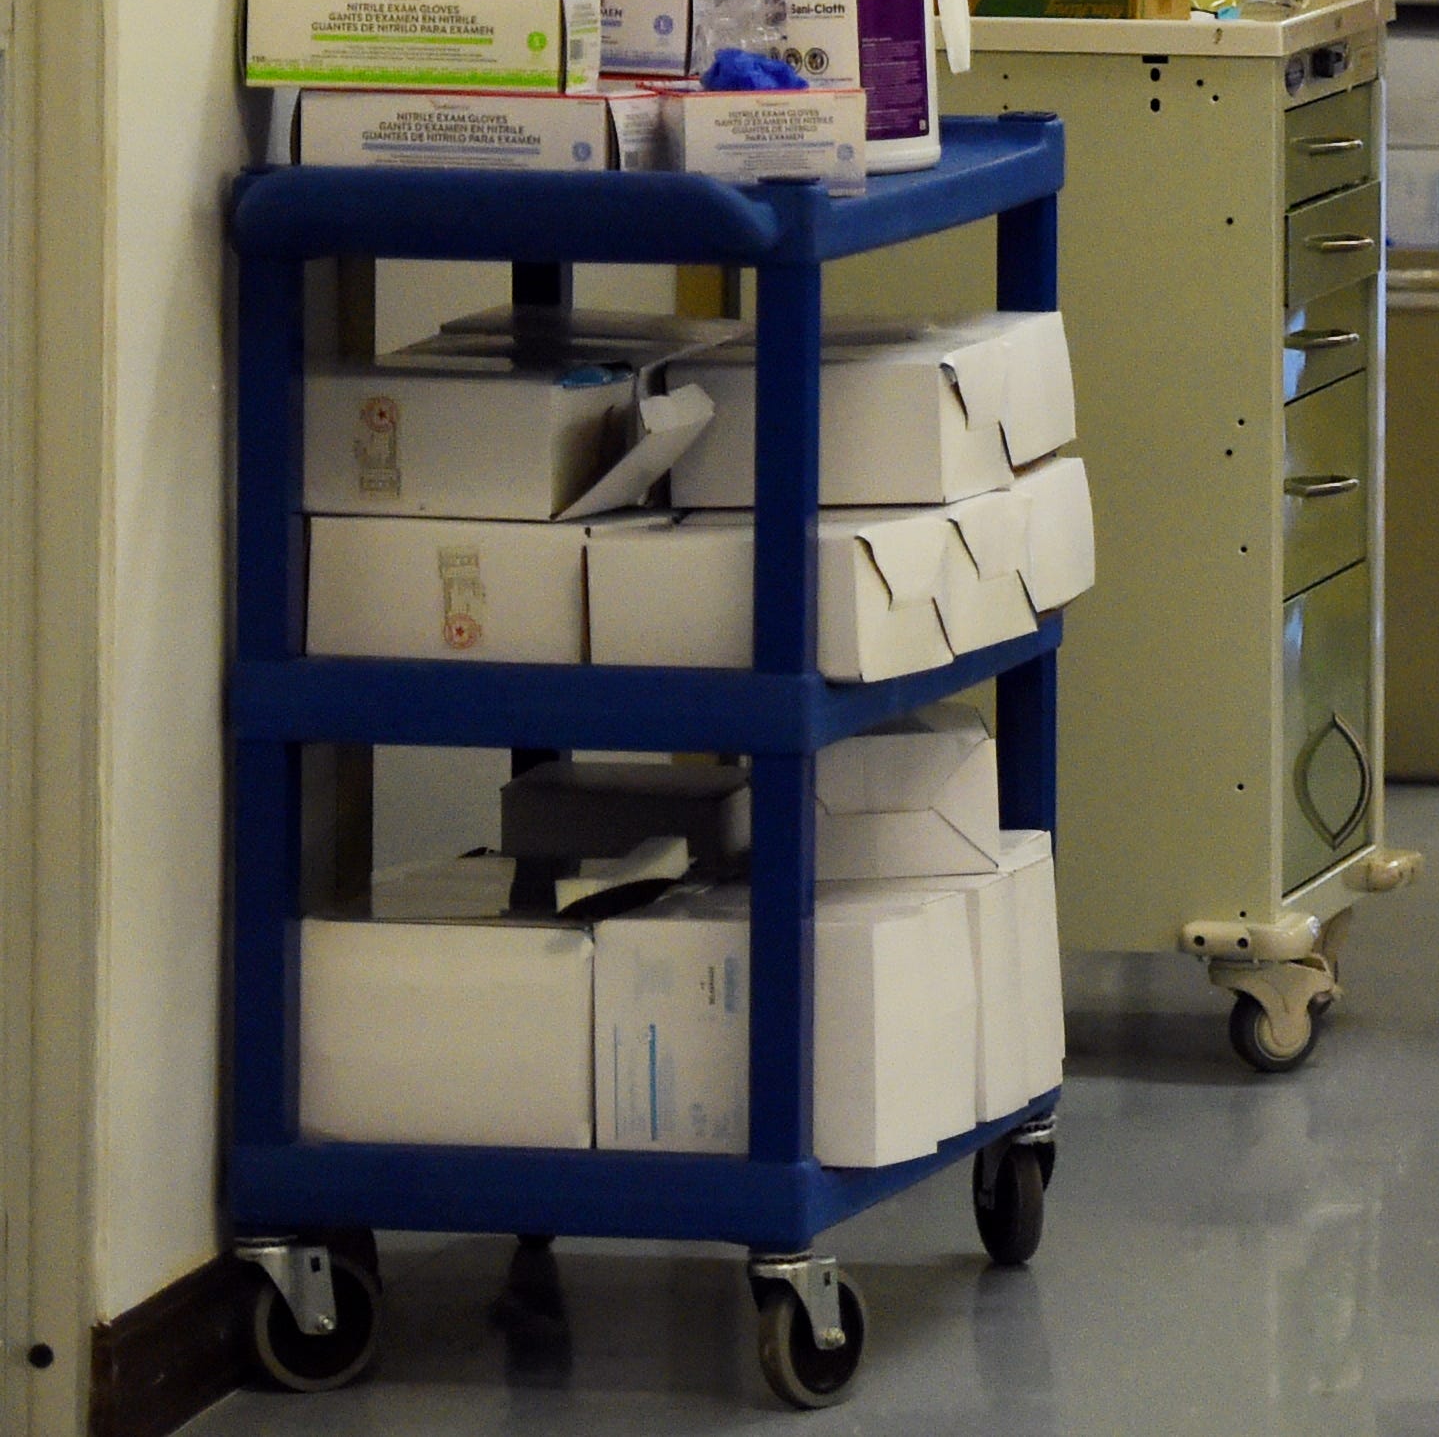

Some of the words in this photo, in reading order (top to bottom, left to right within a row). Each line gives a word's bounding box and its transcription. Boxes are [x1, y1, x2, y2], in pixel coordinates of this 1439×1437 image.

[346, 3, 385, 12] NITRILE
[387, 3, 417, 12] EXAM
[419, 4, 460, 14] GLOVES
[791, 3, 845, 14] Sani-Cloth
[328, 12, 363, 22] GANTS
[421, 14, 436, 23] EN
[439, 15, 477, 24] NITRILE
[311, 22, 358, 31] GUANTES
[361, 23, 375, 32] DE
[377, 24, 417, 33] NITRILO
[420, 24, 447, 34] PARA
[449, 25, 494, 35] EXAMEN
[396, 112, 433, 121] NITRILE
[436, 113, 465, 122] EXAM
[468, 114, 508, 123] GLOVES
[379, 122, 412, 131] GANTS
[470, 124, 484, 133] EN
[487, 125, 524, 134] NITRILE
[362, 131, 408, 140] GUANTES
[410, 132, 425, 141] DE
[427, 132, 466, 142] NITRILO
[469, 134, 495, 143] PARA
[497, 134, 541, 144] EXAMEN
